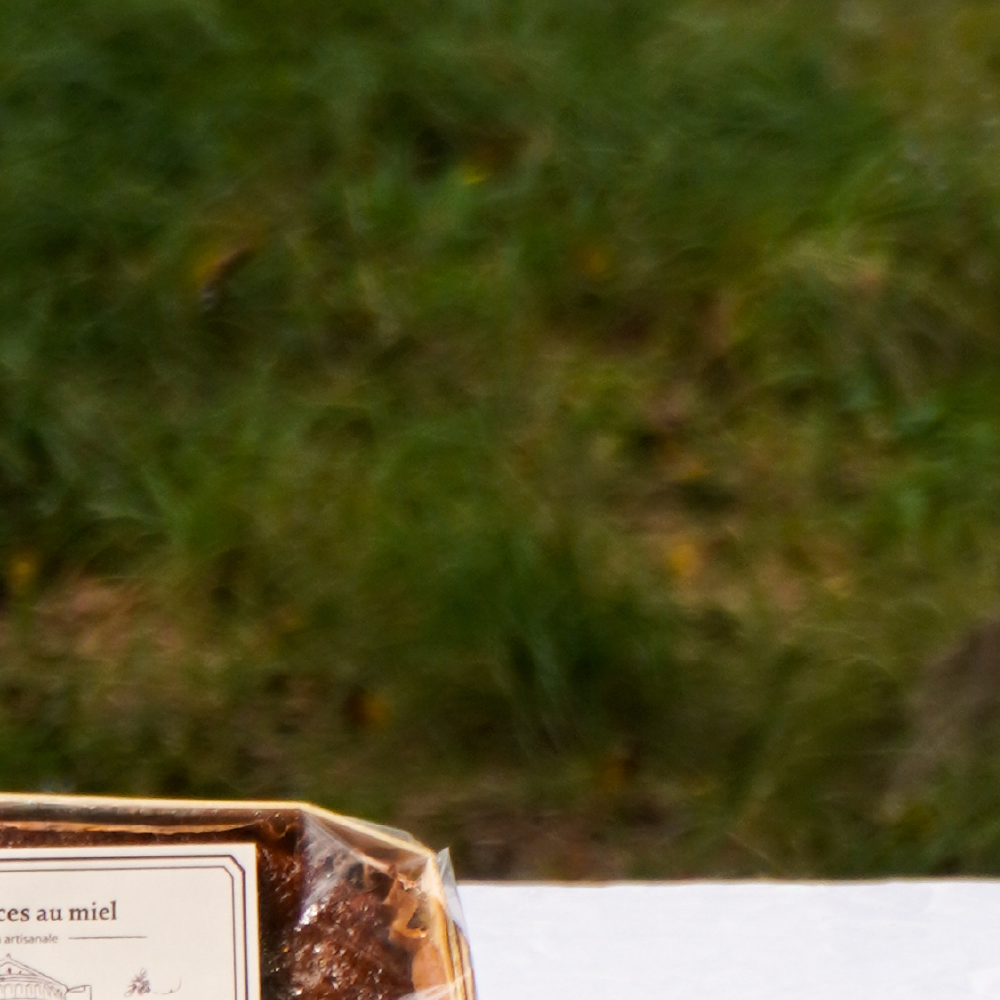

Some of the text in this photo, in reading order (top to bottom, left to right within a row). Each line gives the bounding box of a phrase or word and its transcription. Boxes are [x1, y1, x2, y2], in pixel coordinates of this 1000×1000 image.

[36, 907, 63, 922] au
[68, 900, 118, 922] miel
[3, 933, 59, 945] artisanale
